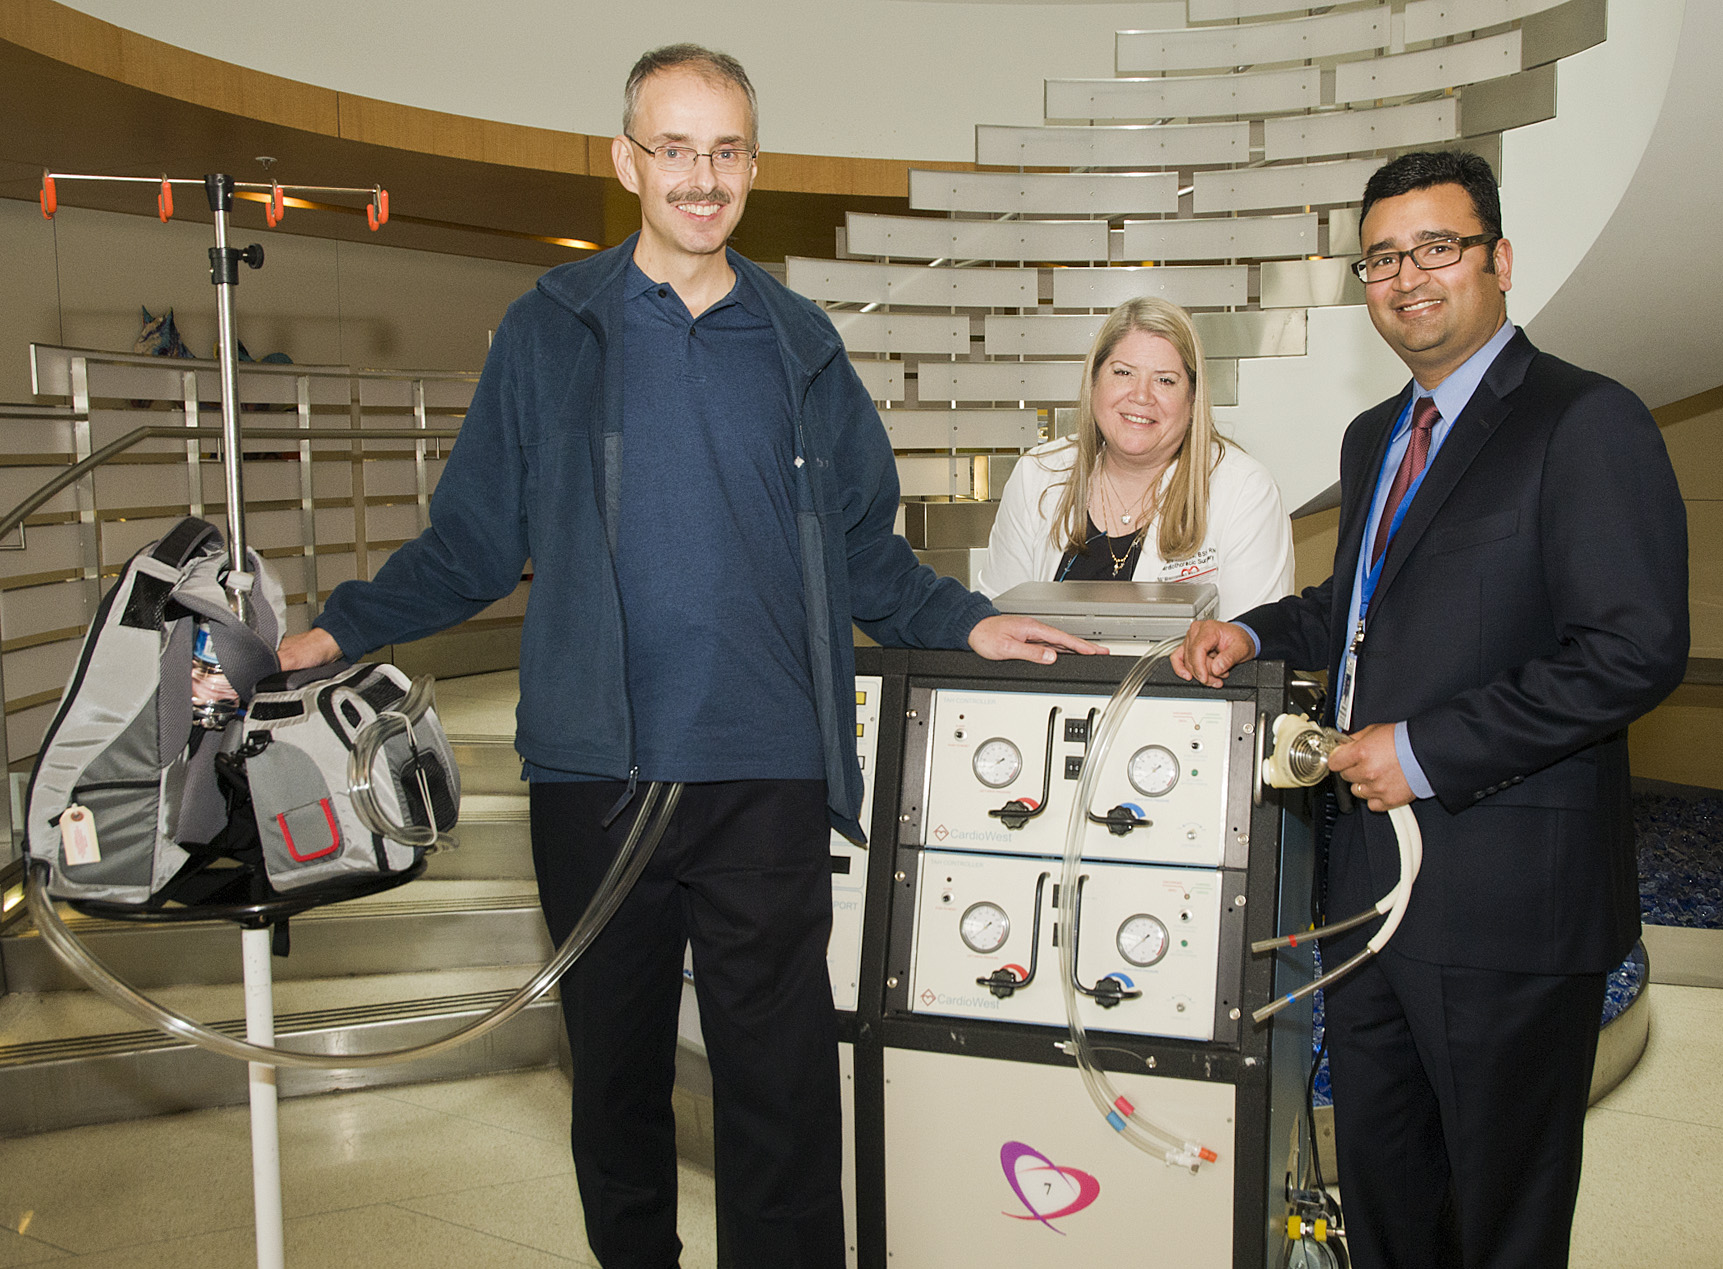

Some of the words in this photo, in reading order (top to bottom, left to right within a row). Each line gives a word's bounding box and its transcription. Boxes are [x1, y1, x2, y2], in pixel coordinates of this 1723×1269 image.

[950, 828, 1012, 843] CardioWest
[937, 993, 1000, 1009] CardioWest
[1044, 1182, 1052, 1195] 7
